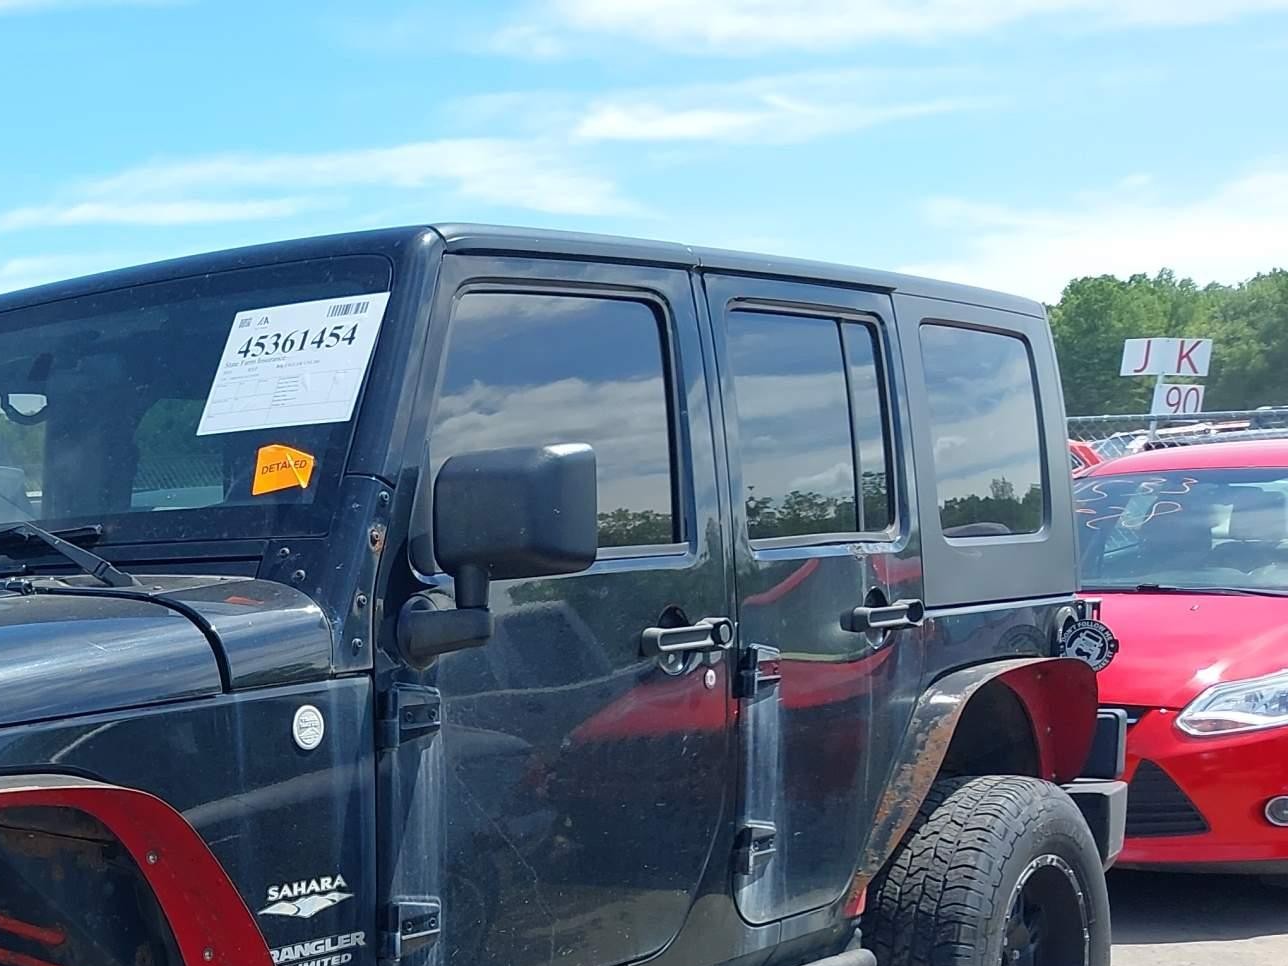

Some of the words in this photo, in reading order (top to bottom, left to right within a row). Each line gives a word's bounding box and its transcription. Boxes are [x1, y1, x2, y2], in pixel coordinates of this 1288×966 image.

[237, 323, 359, 359] 45361454
[1133, 339, 1152, 374] J
[1176, 340, 1203, 374] K
[1165, 386, 1201, 414] 90
[1077, 621, 1106, 632] FOLLOW
[268, 874, 348, 901] SAHARA
[269, 931, 367, 964] RANGLER
